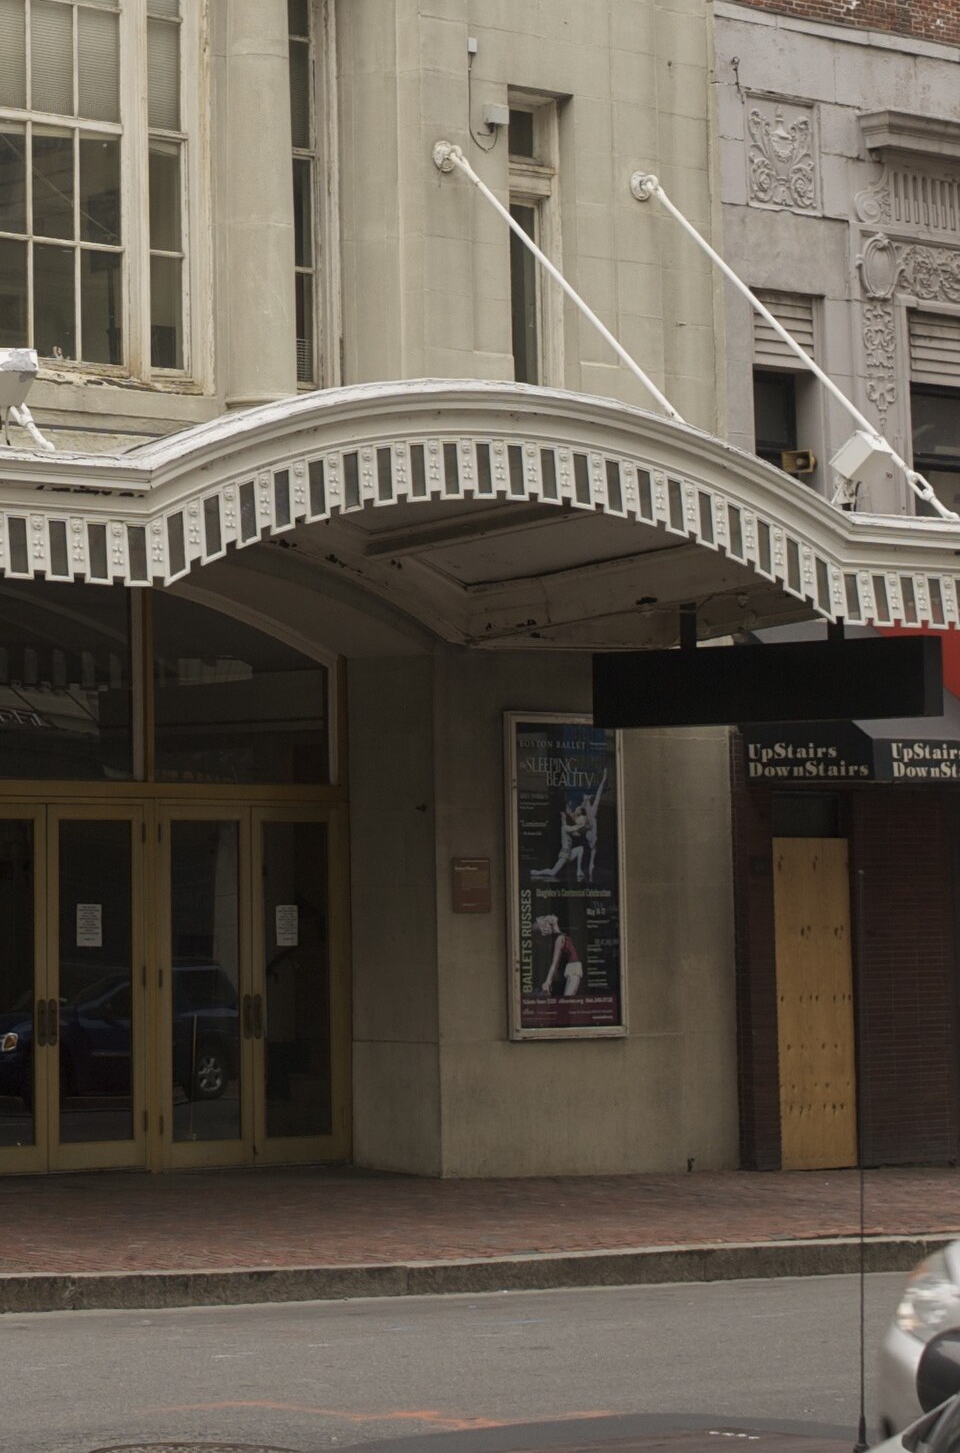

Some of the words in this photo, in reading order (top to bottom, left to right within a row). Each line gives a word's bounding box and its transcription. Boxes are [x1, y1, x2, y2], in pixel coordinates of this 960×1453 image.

[519, 739, 554, 749] BOSTON
[556, 740, 587, 749] BALLET
[748, 742, 838, 763] UpStairs
[890, 742, 960, 763] UpStair
[526, 756, 577, 774] SLEEPING
[748, 760, 870, 778] DownStairs
[892, 760, 960, 779] DownSt
[546, 771, 595, 788] BEAUTY
[520, 889, 532, 937] RUSSES
[522, 940, 534, 993] BALLETS
